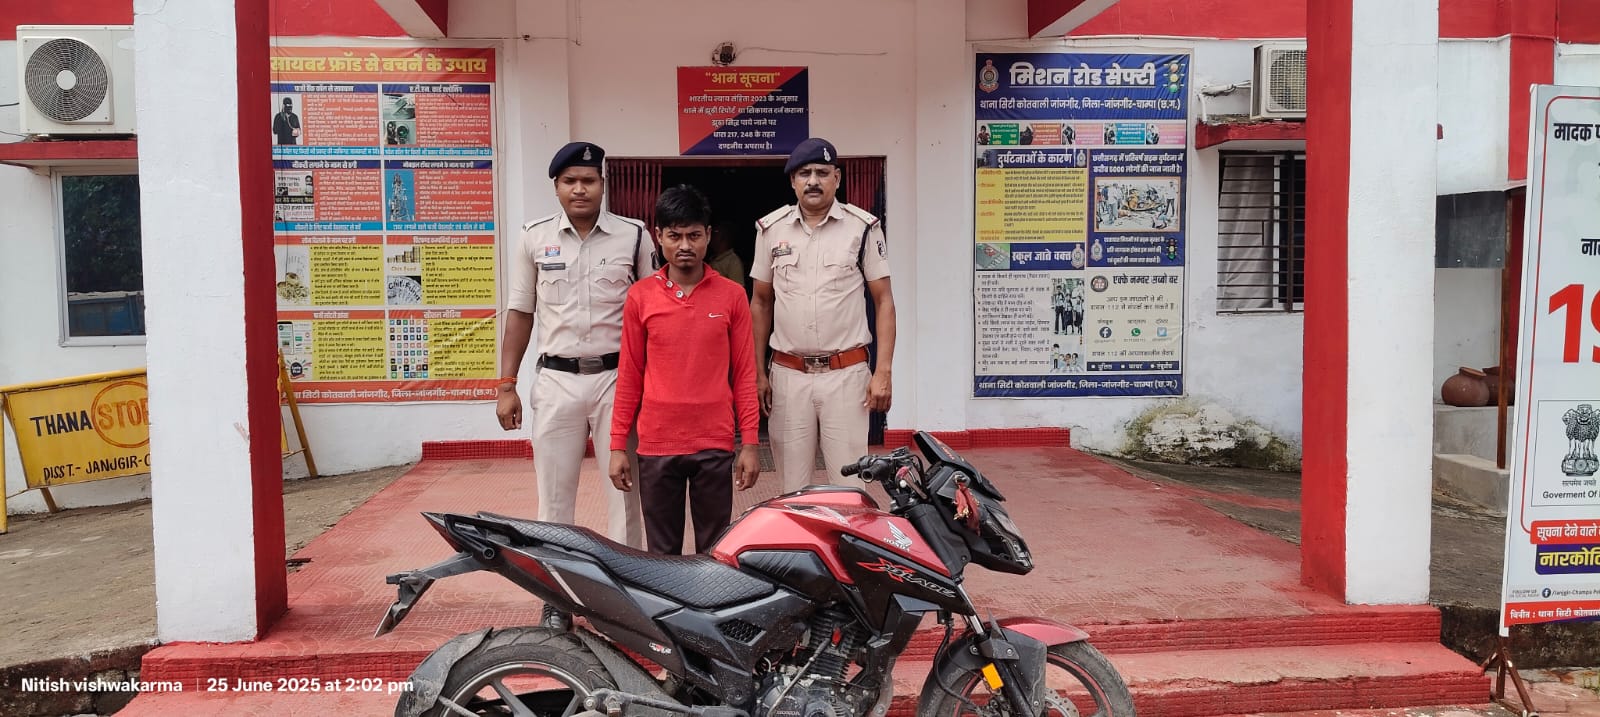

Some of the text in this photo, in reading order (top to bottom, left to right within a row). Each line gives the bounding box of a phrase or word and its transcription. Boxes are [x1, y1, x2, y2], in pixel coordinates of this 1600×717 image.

[271, 53, 487, 73] सायबर फ्रॉड से बचने के उपाय
[1009, 61, 1157, 86] मिशन रोड सेफ्टी
[689, 94, 713, 102] भारतीय
[731, 94, 750, 103] संहिता
[768, 94, 775, 102] के
[776, 96, 799, 105] अनुसार
[980, 98, 998, 109] थाना
[999, 97, 1015, 109] सिटी
[1016, 98, 1049, 109] कोतवाली
[718, 106, 736, 114] रिपोर्ट
[746, 106, 773, 114] शिकायत
[1554, 123, 1593, 141] मादक
[718, 142, 743, 151] दण्डनीय
[998, 151, 1072, 168] दुर्घटनाओं के कारण
[1012, 251, 1032, 265] स्कूल
[1034, 249, 1052, 261] जाते
[997, 380, 1013, 389] सिटी
[1015, 380, 1046, 389] कोतवाली
[30, 410, 94, 437] THANA
[1543, 491, 1586, 499] Goverment
[1588, 490, 1597, 498] Of
[1537, 526, 1563, 541] सूचना
[1564, 524, 1578, 537] देने
[1580, 524, 1597, 537] वाले
[1556, 608, 1571, 617] सिटी
